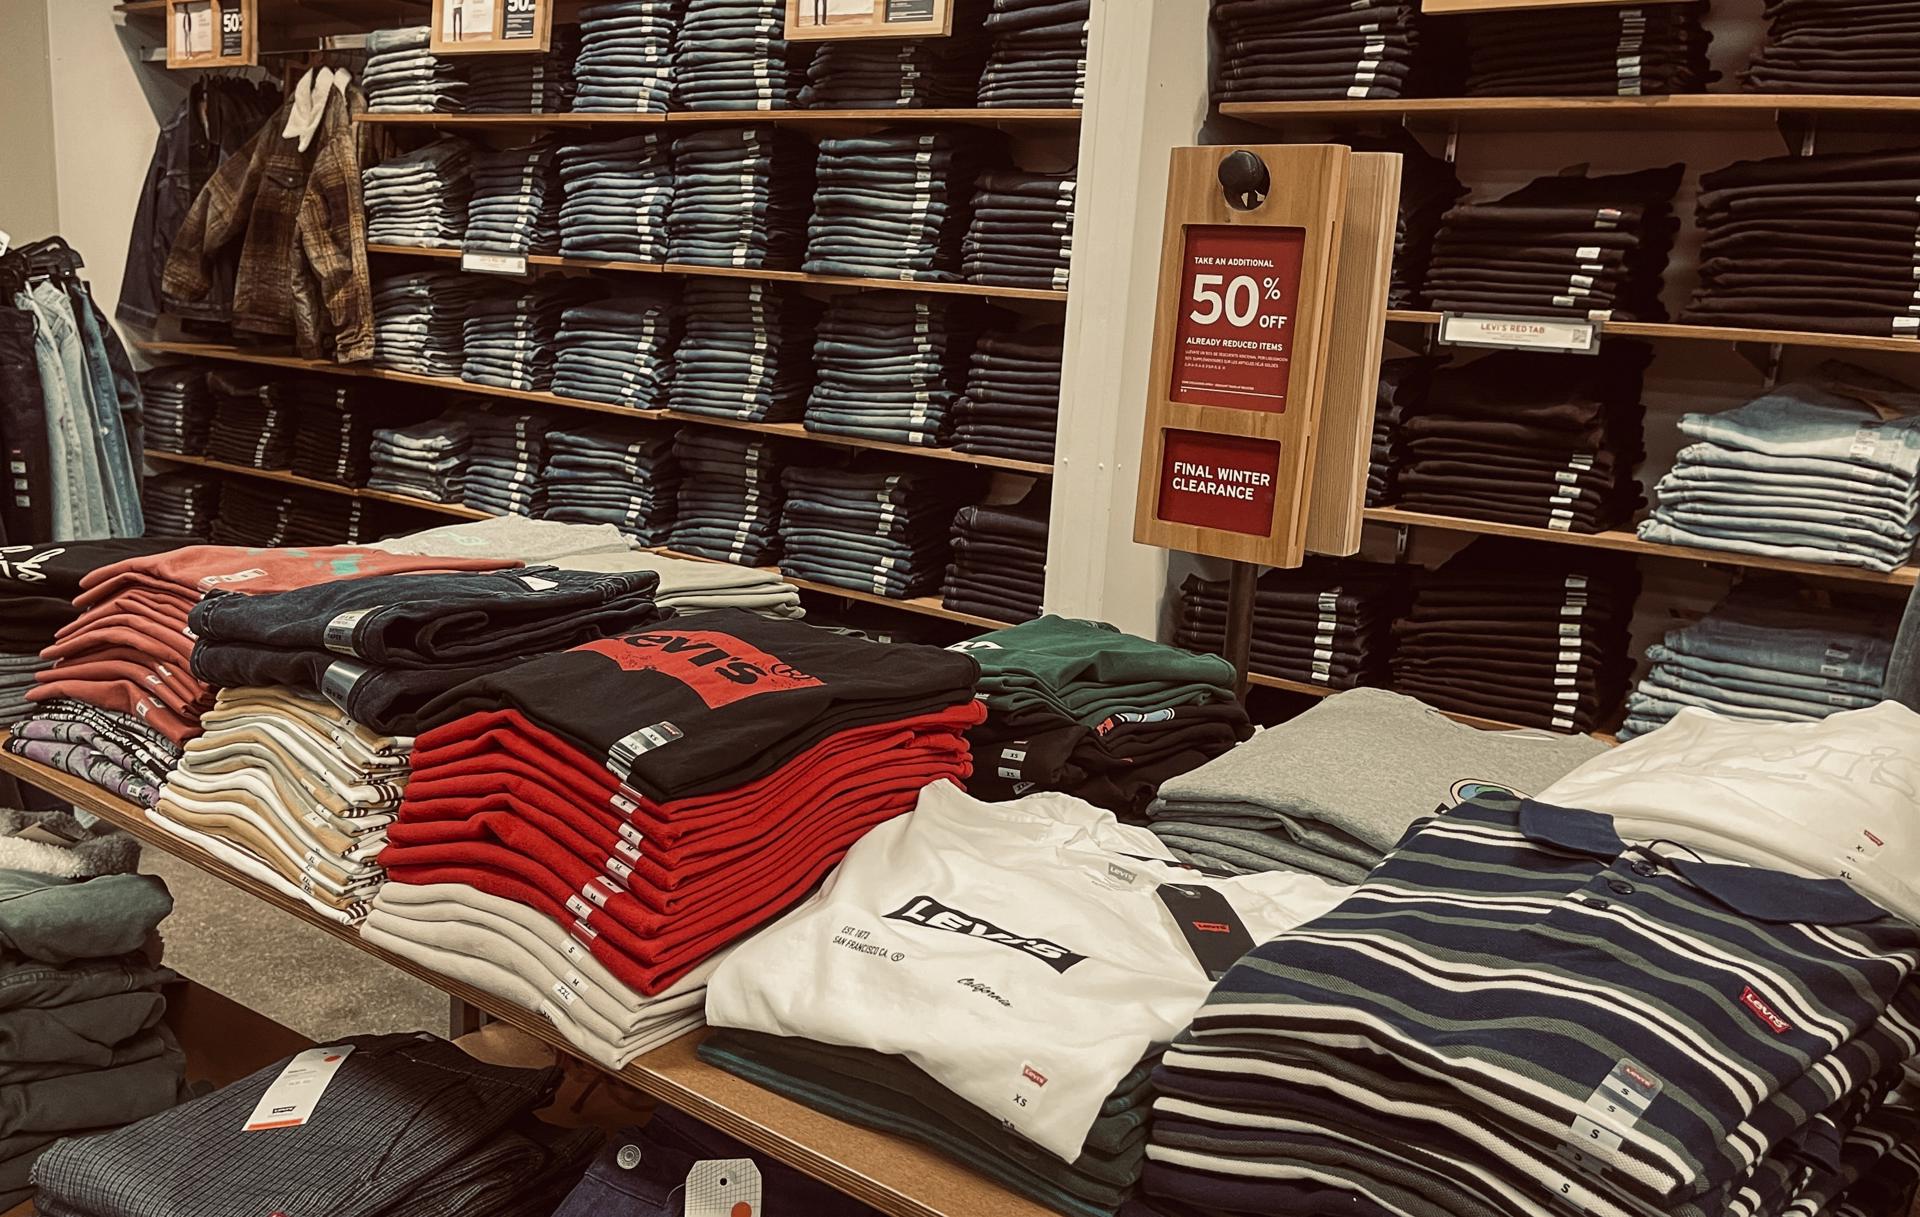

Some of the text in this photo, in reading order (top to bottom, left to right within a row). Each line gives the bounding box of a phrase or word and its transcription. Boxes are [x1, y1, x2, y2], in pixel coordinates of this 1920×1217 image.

[1194, 256, 1214, 265] TAKE
[1227, 258, 1274, 268] ADDITIONAL
[1259, 315, 1288, 329] OFF
[1510, 324, 1527, 332] RED
[1528, 326, 1546, 334] TAB
[1186, 336, 1283, 352] ALREADY REDUCED ITEMS
[1174, 462, 1270, 486] FINAL WINTER
[1172, 478, 1254, 500] CLEARANCE
[1840, 870, 1852, 880] XL
[855, 930, 870, 940] 1873
[833, 936, 847, 945] SAN
[846, 940, 879, 955] FRANCISCO
[558, 986, 570, 1000] XXL
[957, 978, 1013, 1008] California
[1013, 1093, 1027, 1107] XS
[1590, 1129, 1600, 1139] S
[1561, 1183, 1571, 1194] S
